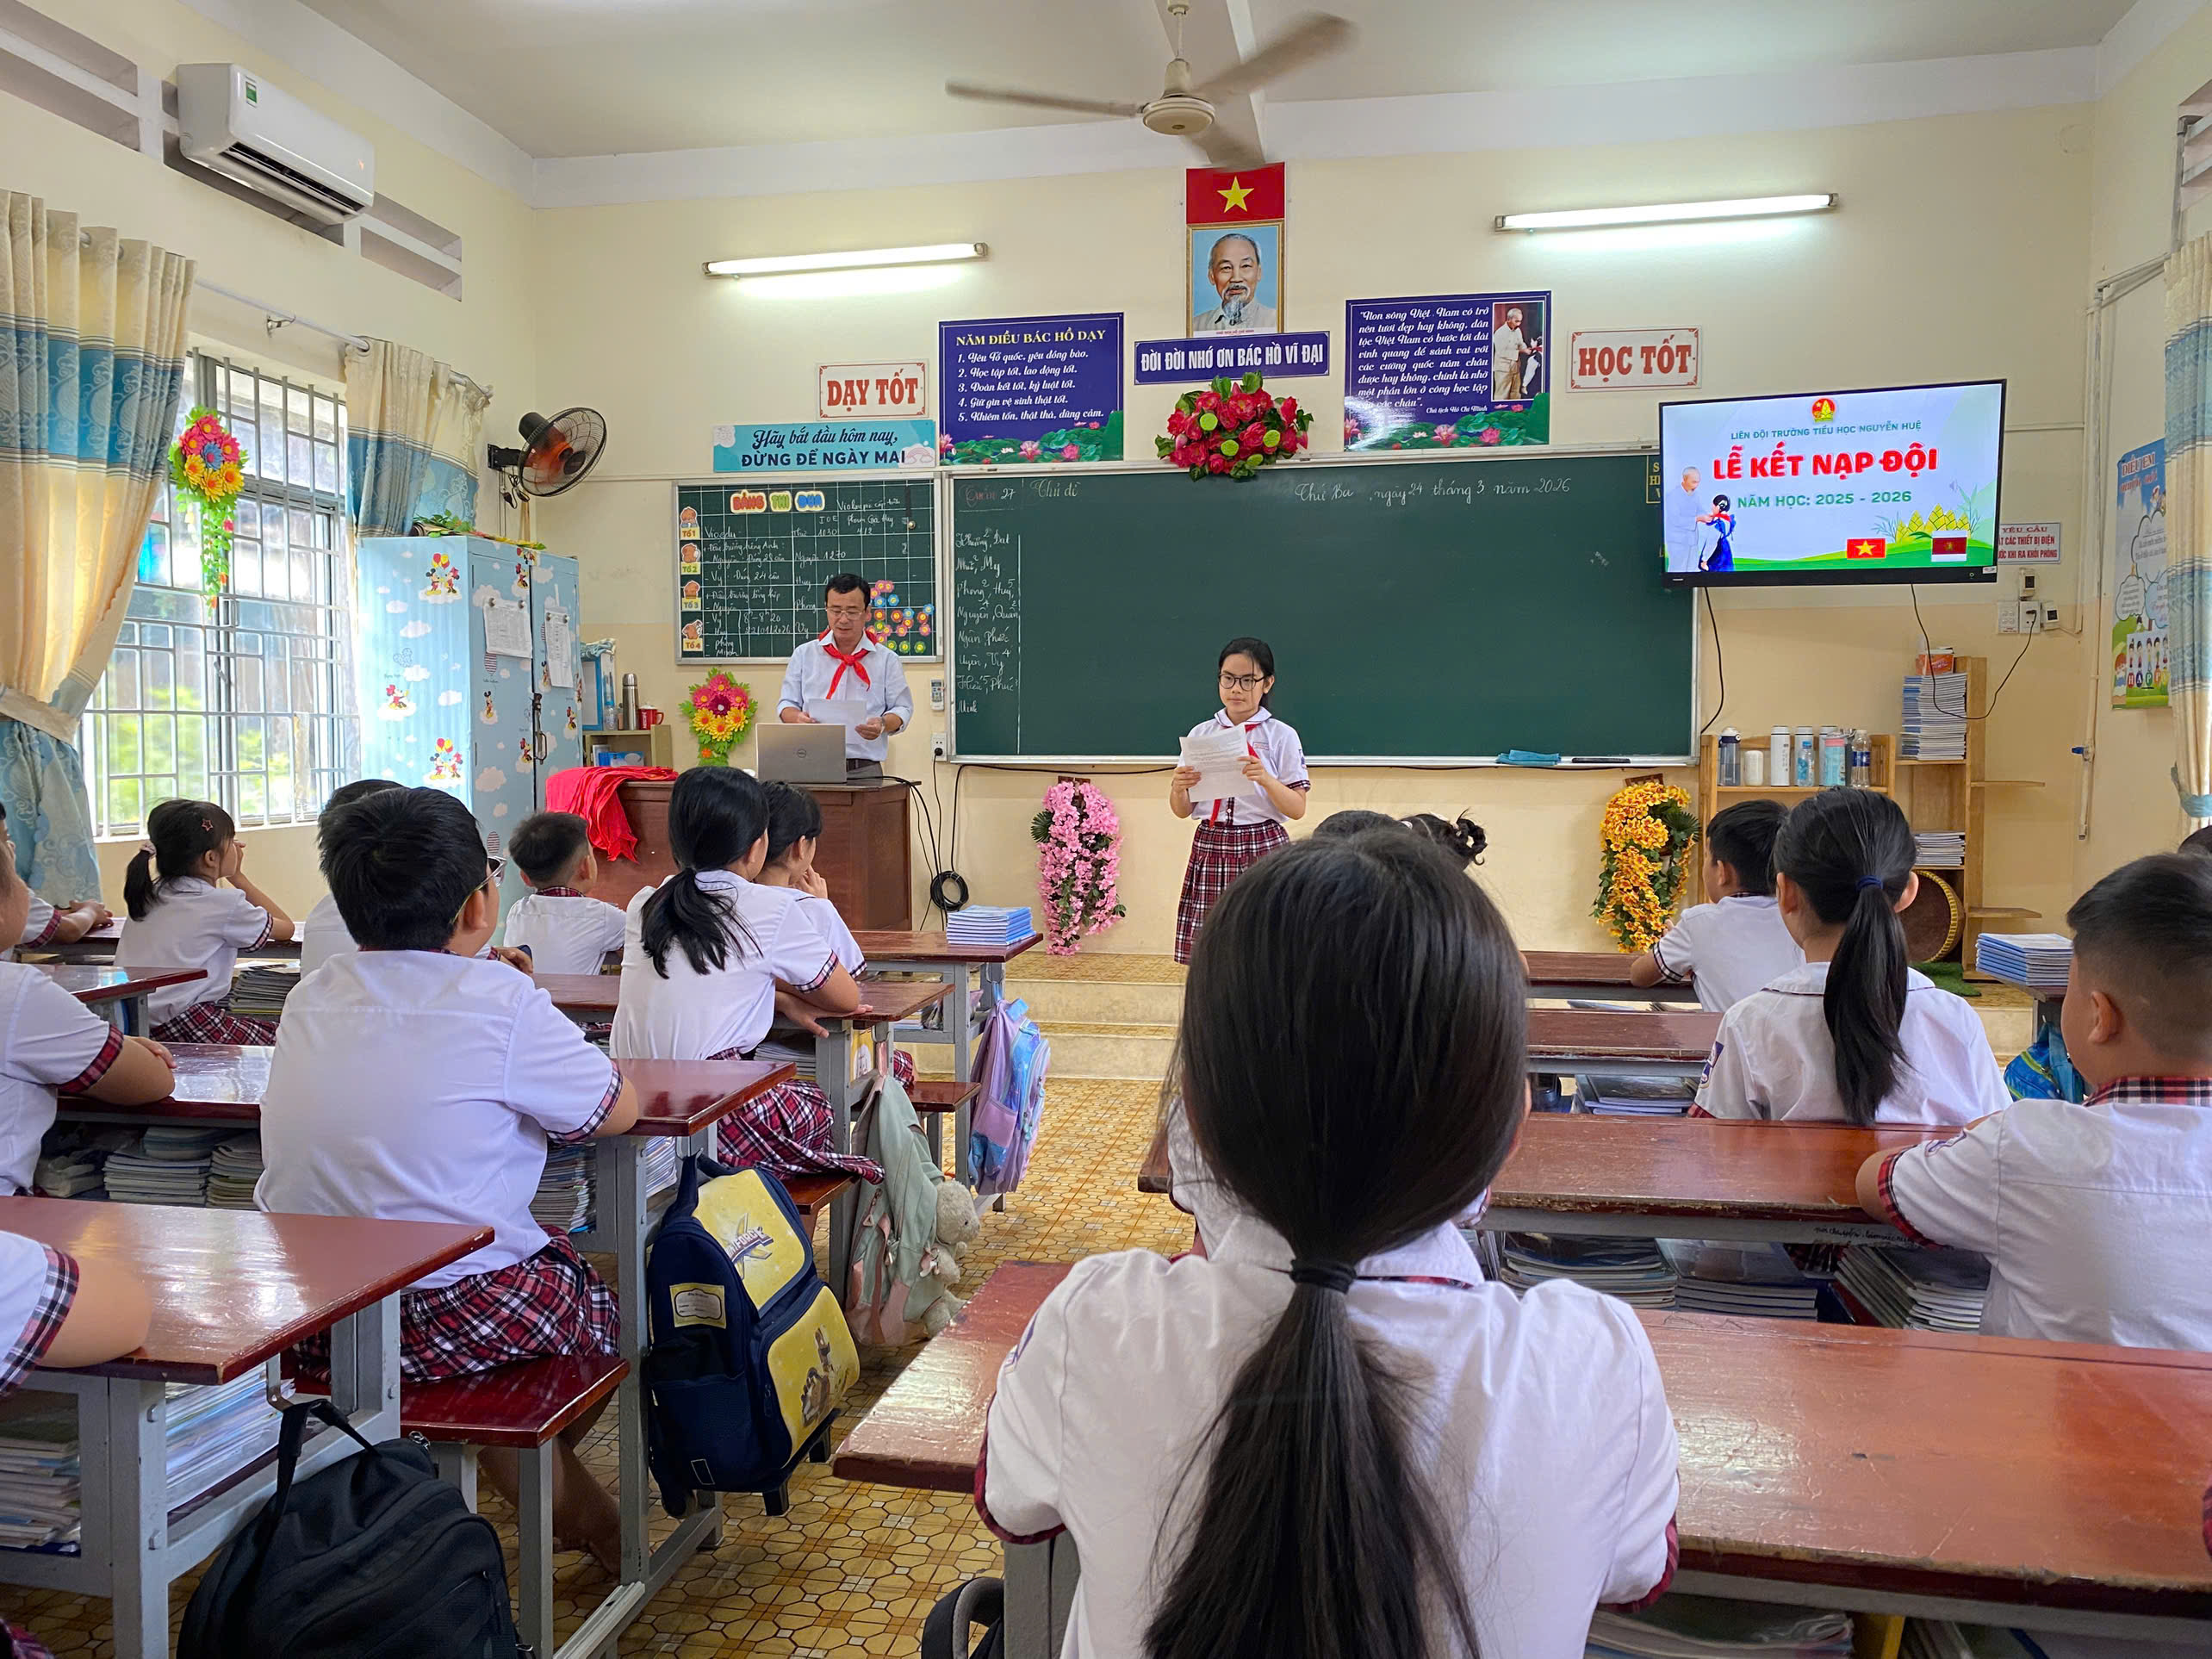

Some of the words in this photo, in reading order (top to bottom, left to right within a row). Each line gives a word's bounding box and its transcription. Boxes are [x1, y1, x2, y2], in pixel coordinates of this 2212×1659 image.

[1385, 312, 1407, 321] sông
[1410, 308, 1430, 320] Việt
[1436, 308, 1459, 317] Nam
[1417, 321, 1434, 332] hay
[956, 334, 985, 345] NĂM
[989, 330, 1020, 344] ĐIỀU
[1024, 331, 1051, 343] BÁC
[1054, 327, 1073, 341] HỒ
[1078, 330, 1105, 342] DẠY
[1375, 336, 1395, 346] Việt
[1398, 334, 1420, 344] Nam
[967, 352, 986, 363] Yêu
[1028, 352, 1044, 363] yêu
[1140, 350, 1162, 372] ĐỜI
[1165, 348, 1185, 370] ĐỜI
[1189, 346, 1214, 369] NHỚ
[1216, 350, 1233, 368] ƠN
[1238, 344, 1261, 366] BÁC
[1266, 342, 1282, 364] HỒ
[1285, 343, 1298, 363] VĨ
[1302, 344, 1324, 366] ĐẠI
[1358, 349, 1377, 358] vinh
[1382, 351, 1409, 360] quang
[1429, 345, 1452, 355] sánh
[1578, 346, 1633, 382] HỌC
[1640, 334, 1692, 374] TỐT
[1413, 360, 1434, 371] quốc
[1466, 357, 1488, 366] châu
[970, 367, 989, 378] Học
[1024, 366, 1037, 375] lao
[1382, 374, 1398, 385] hay
[1433, 371, 1457, 380] chính
[1460, 370, 1469, 379] là
[827, 379, 869, 412] DẠY
[876, 369, 918, 405] TỐT
[971, 382, 994, 391] Đoàn
[997, 382, 1010, 391] kết
[1429, 386, 1450, 395] công
[1453, 383, 1469, 394] học
[1473, 384, 1488, 394] tập
[1014, 395, 1033, 405] sinh
[971, 412, 999, 421] Khiêm
[1730, 431, 1750, 440] LIÊN
[1754, 429, 1768, 439] ĐỘI
[1772, 427, 1809, 438] TRƯỜNG
[1813, 425, 1833, 435] TIỂU
[1837, 426, 1855, 434] HỌC
[1859, 420, 1898, 432] NGUYỄN
[1902, 420, 1922, 432] HUỆ
[752, 427, 785, 450] Hãy
[789, 426, 810, 444] bắt
[812, 426, 835, 443] đầu
[839, 427, 866, 443] hôm
[869, 431, 898, 446] nay,
[742, 451, 791, 466] ĐỪNG
[796, 449, 817, 465] ĐỂ
[823, 448, 869, 465] NGÀY
[874, 450, 905, 463] MAI
[1713, 445, 1743, 480] LỄ
[1750, 441, 1804, 478] KẾT
[1812, 451, 1874, 480] NẠP
[1879, 442, 1938, 477] ĐỘI
[1295, 482, 1326, 501] Thứ
[1332, 484, 1354, 500] Ba
[1408, 482, 1423, 494] 24
[1433, 478, 1471, 504] tháng
[1476, 480, 1485, 494] 3
[1494, 482, 1530, 494] năm
[1535, 478, 1571, 493] 2026
[1737, 494, 1769, 508] NĂM
[1776, 495, 1810, 509] HỌC:
[1816, 494, 1854, 505] 2025
[1872, 491, 1912, 503] 2026
[2005, 536, 2016, 544] CÁC
[2018, 534, 2033, 544] THIẾT
[2035, 537, 2040, 546] BỊ
[2041, 535, 2054, 546] ĐIỆN
[2041, 548, 2057, 557] PHÒNG
